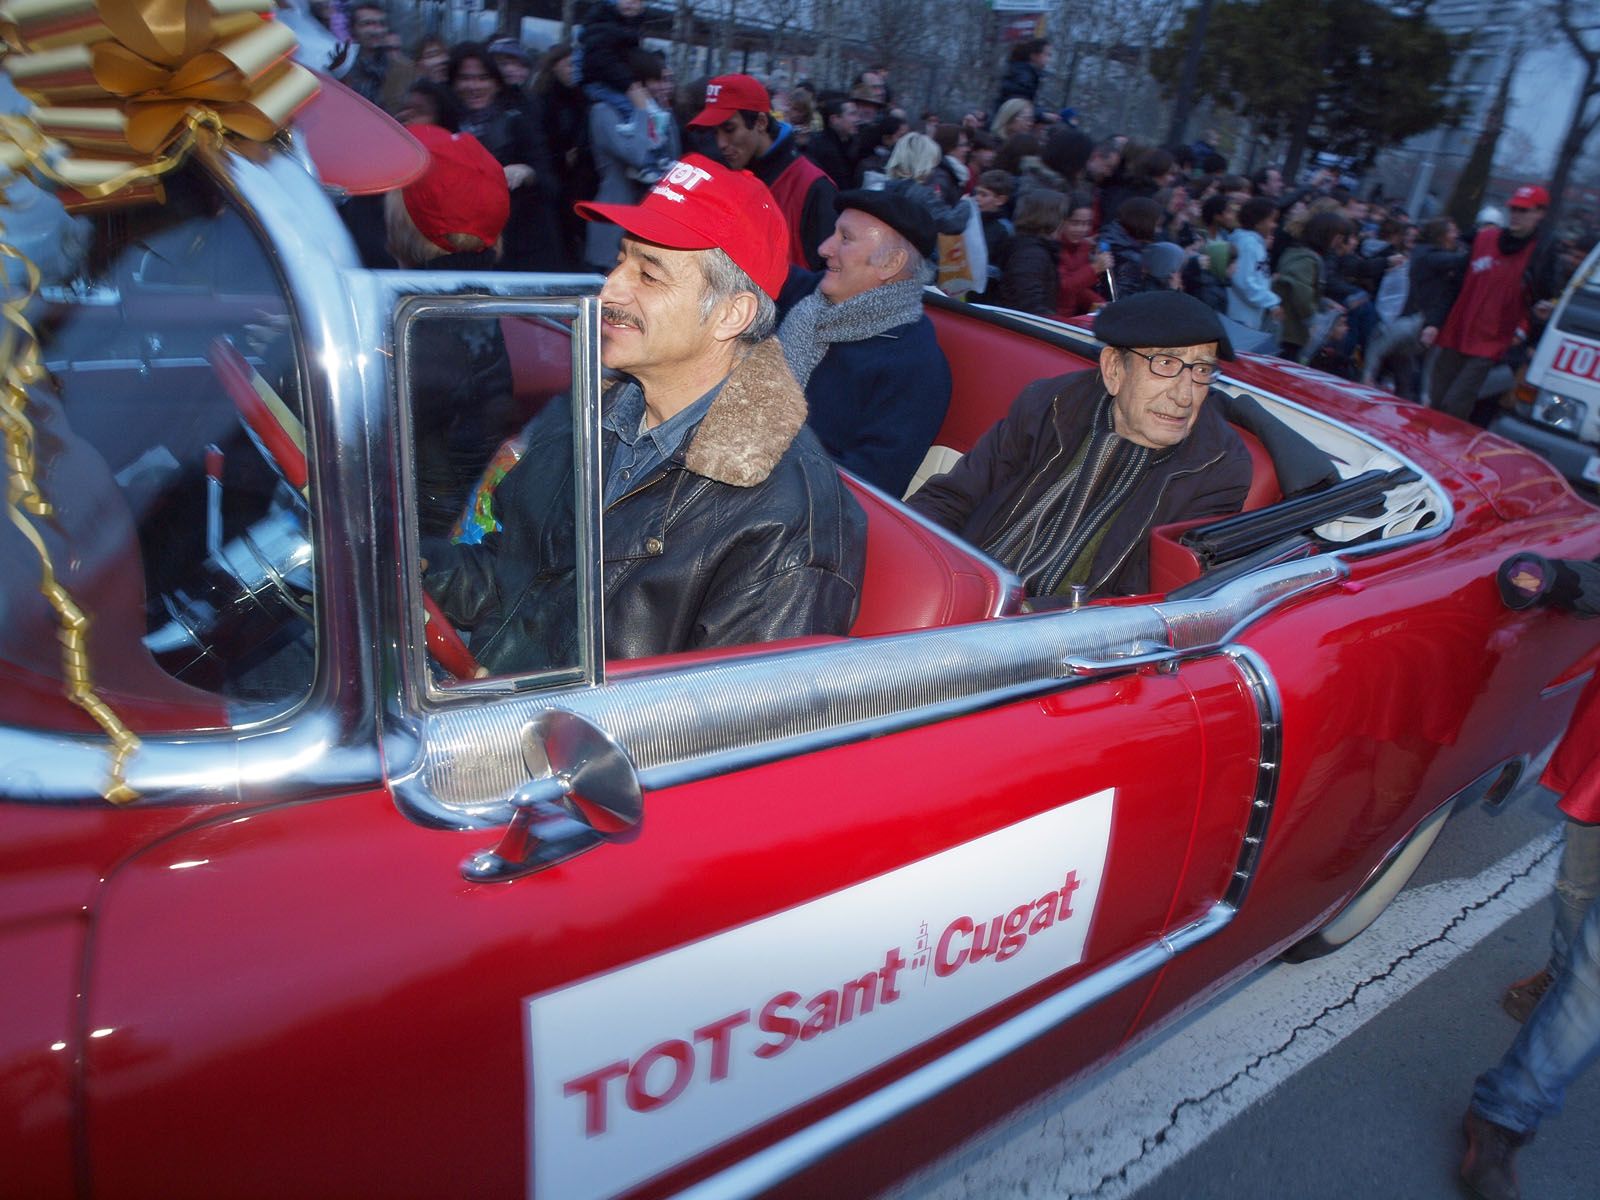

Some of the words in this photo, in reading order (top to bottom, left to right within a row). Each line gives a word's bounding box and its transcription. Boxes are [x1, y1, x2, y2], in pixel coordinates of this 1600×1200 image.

[706, 84, 722, 97] OT
[563, 1007, 751, 1139] TOT
[753, 945, 905, 1060] Sant
[933, 868, 1081, 978] Cugat
